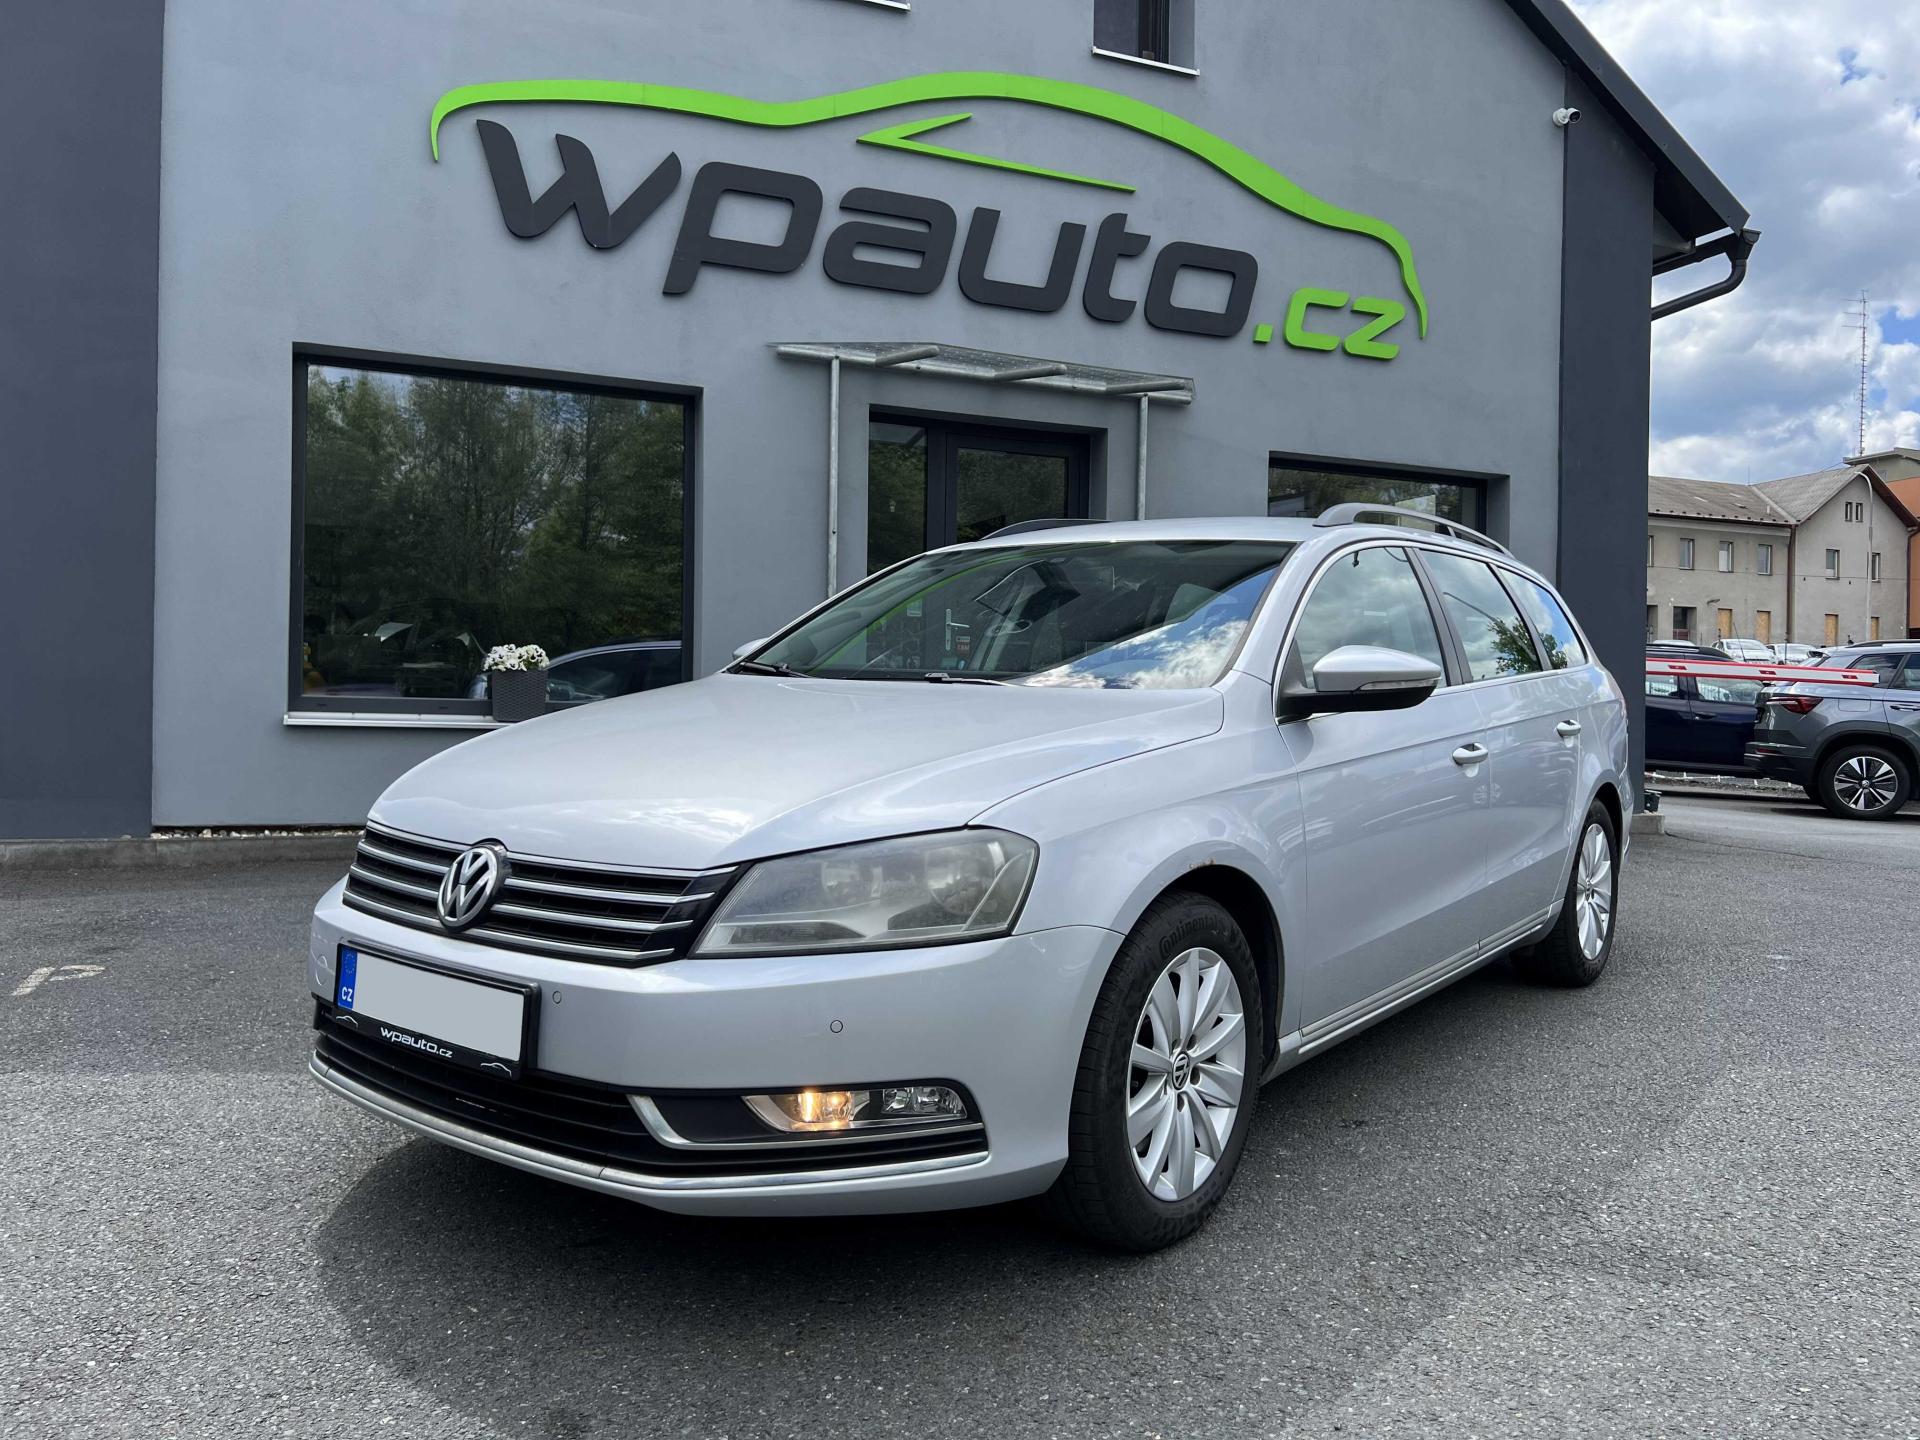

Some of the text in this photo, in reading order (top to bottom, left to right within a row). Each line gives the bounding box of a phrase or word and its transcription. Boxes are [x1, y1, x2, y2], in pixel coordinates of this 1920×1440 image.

[476, 118, 1407, 361] wpauto.cz
[341, 986, 354, 1002] CZ
[380, 1027, 453, 1058] wpauto.cz
